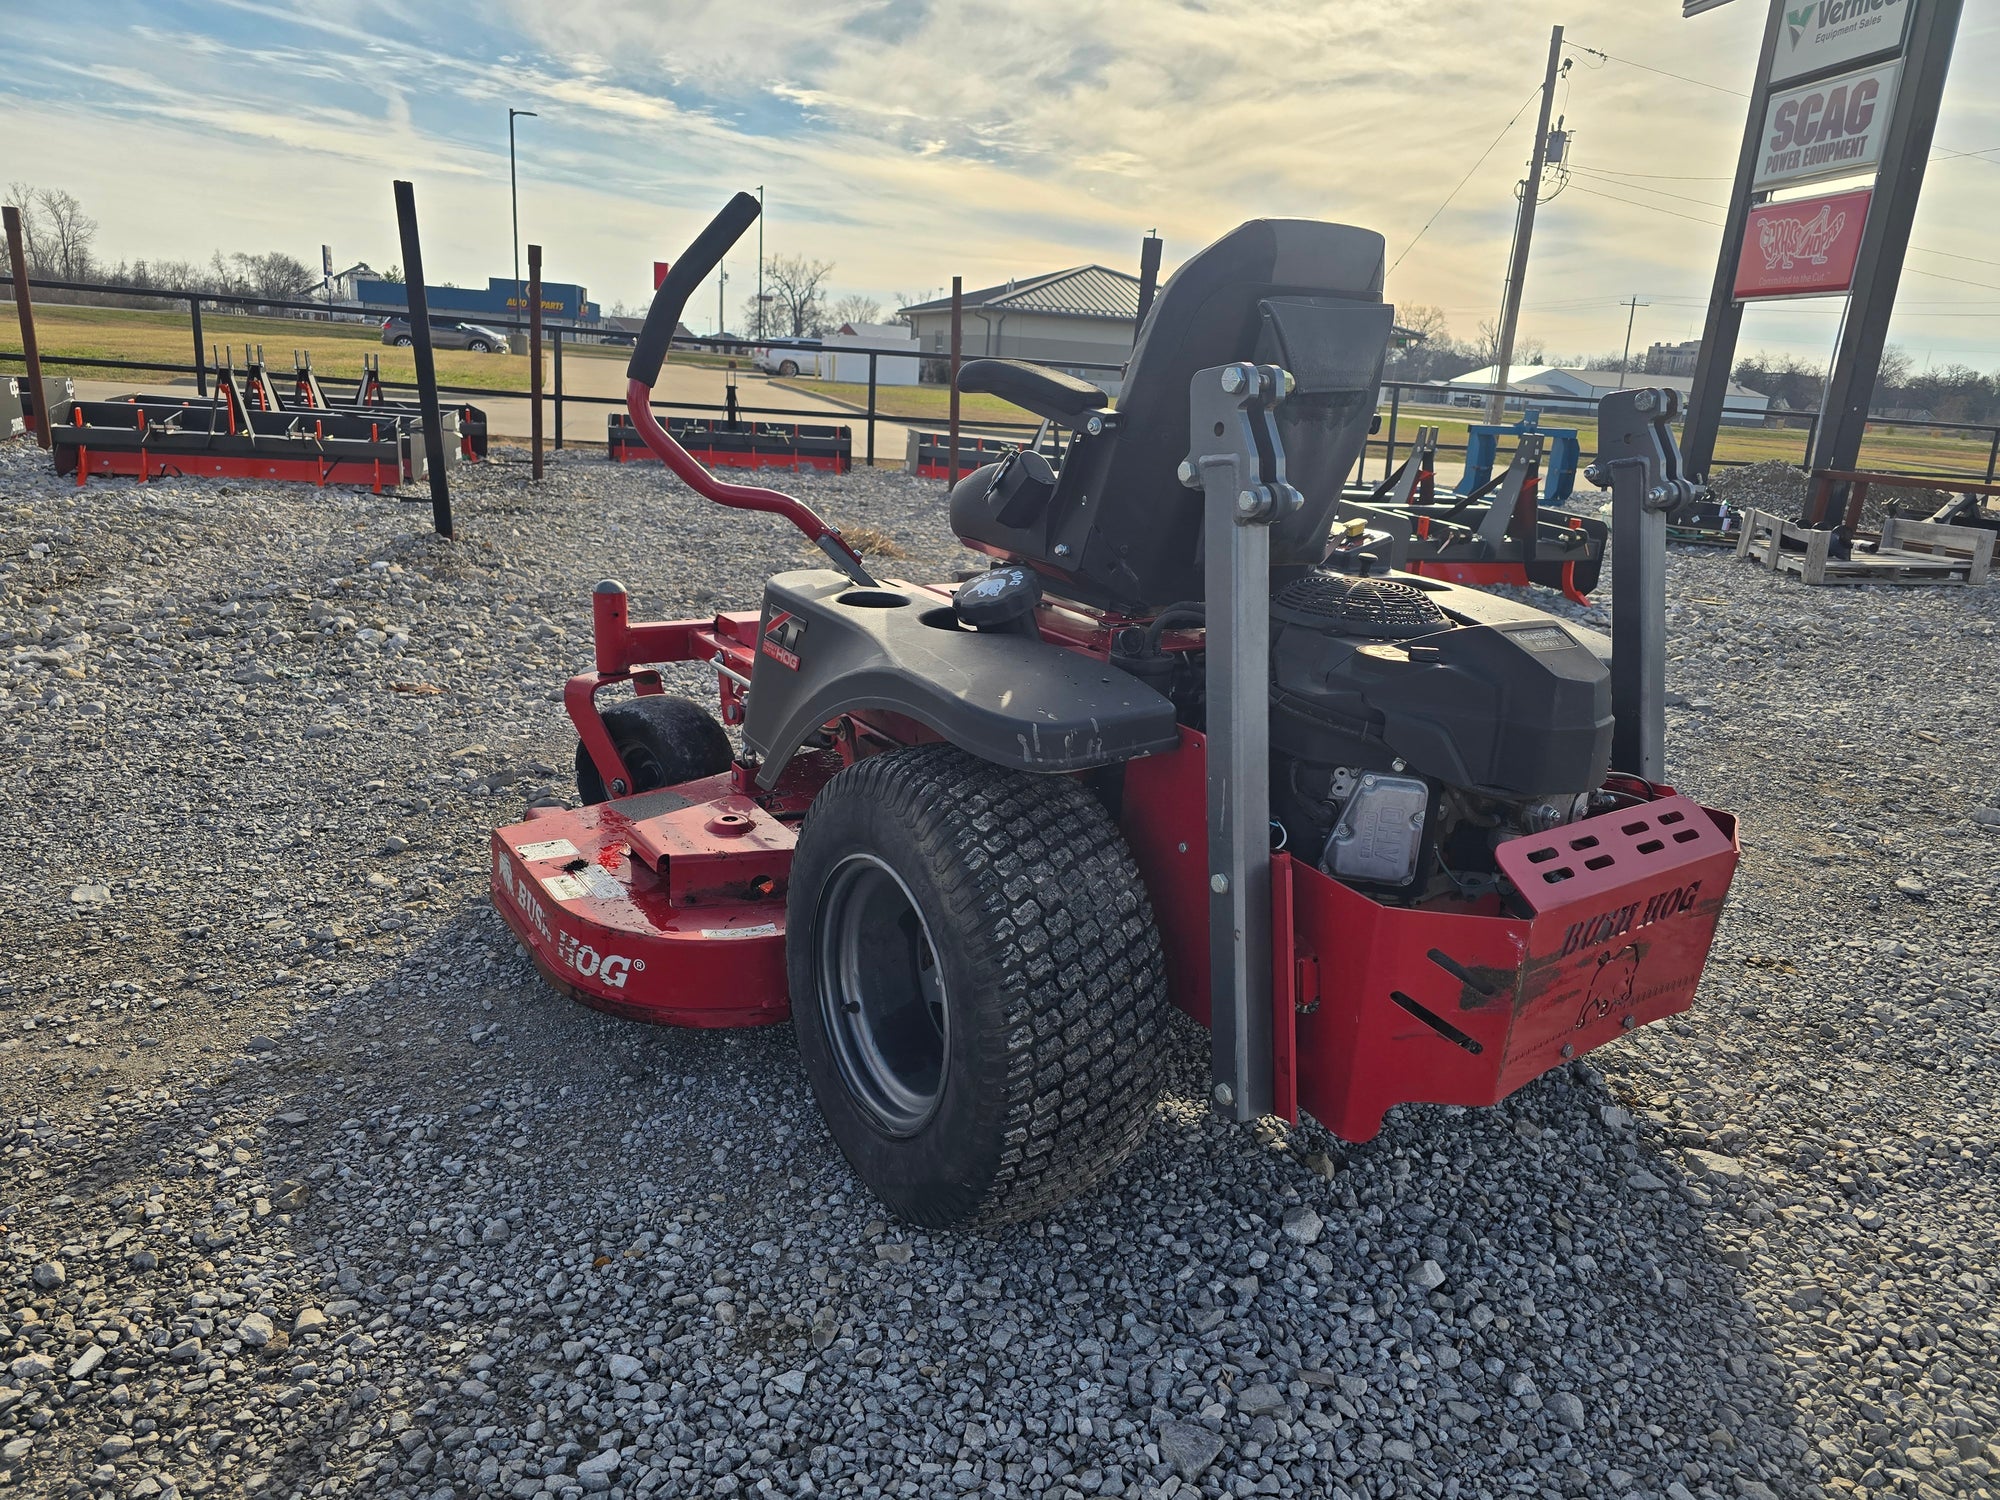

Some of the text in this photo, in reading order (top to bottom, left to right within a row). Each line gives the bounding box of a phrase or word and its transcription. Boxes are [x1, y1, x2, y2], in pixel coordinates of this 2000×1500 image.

[1815, 14, 1882, 44] Equipment Sales
[1818, 0, 1902, 29] Verm
[1770, 78, 1880, 152] SCAG
[1764, 135, 1868, 175] POWER EQUIPMENT
[1759, 275, 1792, 287] Committed
[1792, 275, 1801, 283] to
[1800, 273, 1812, 283] the
[540, 300, 565, 312] PARTS
[775, 648, 799, 670] HOG
[1560, 880, 1702, 958] BUSH HOG
